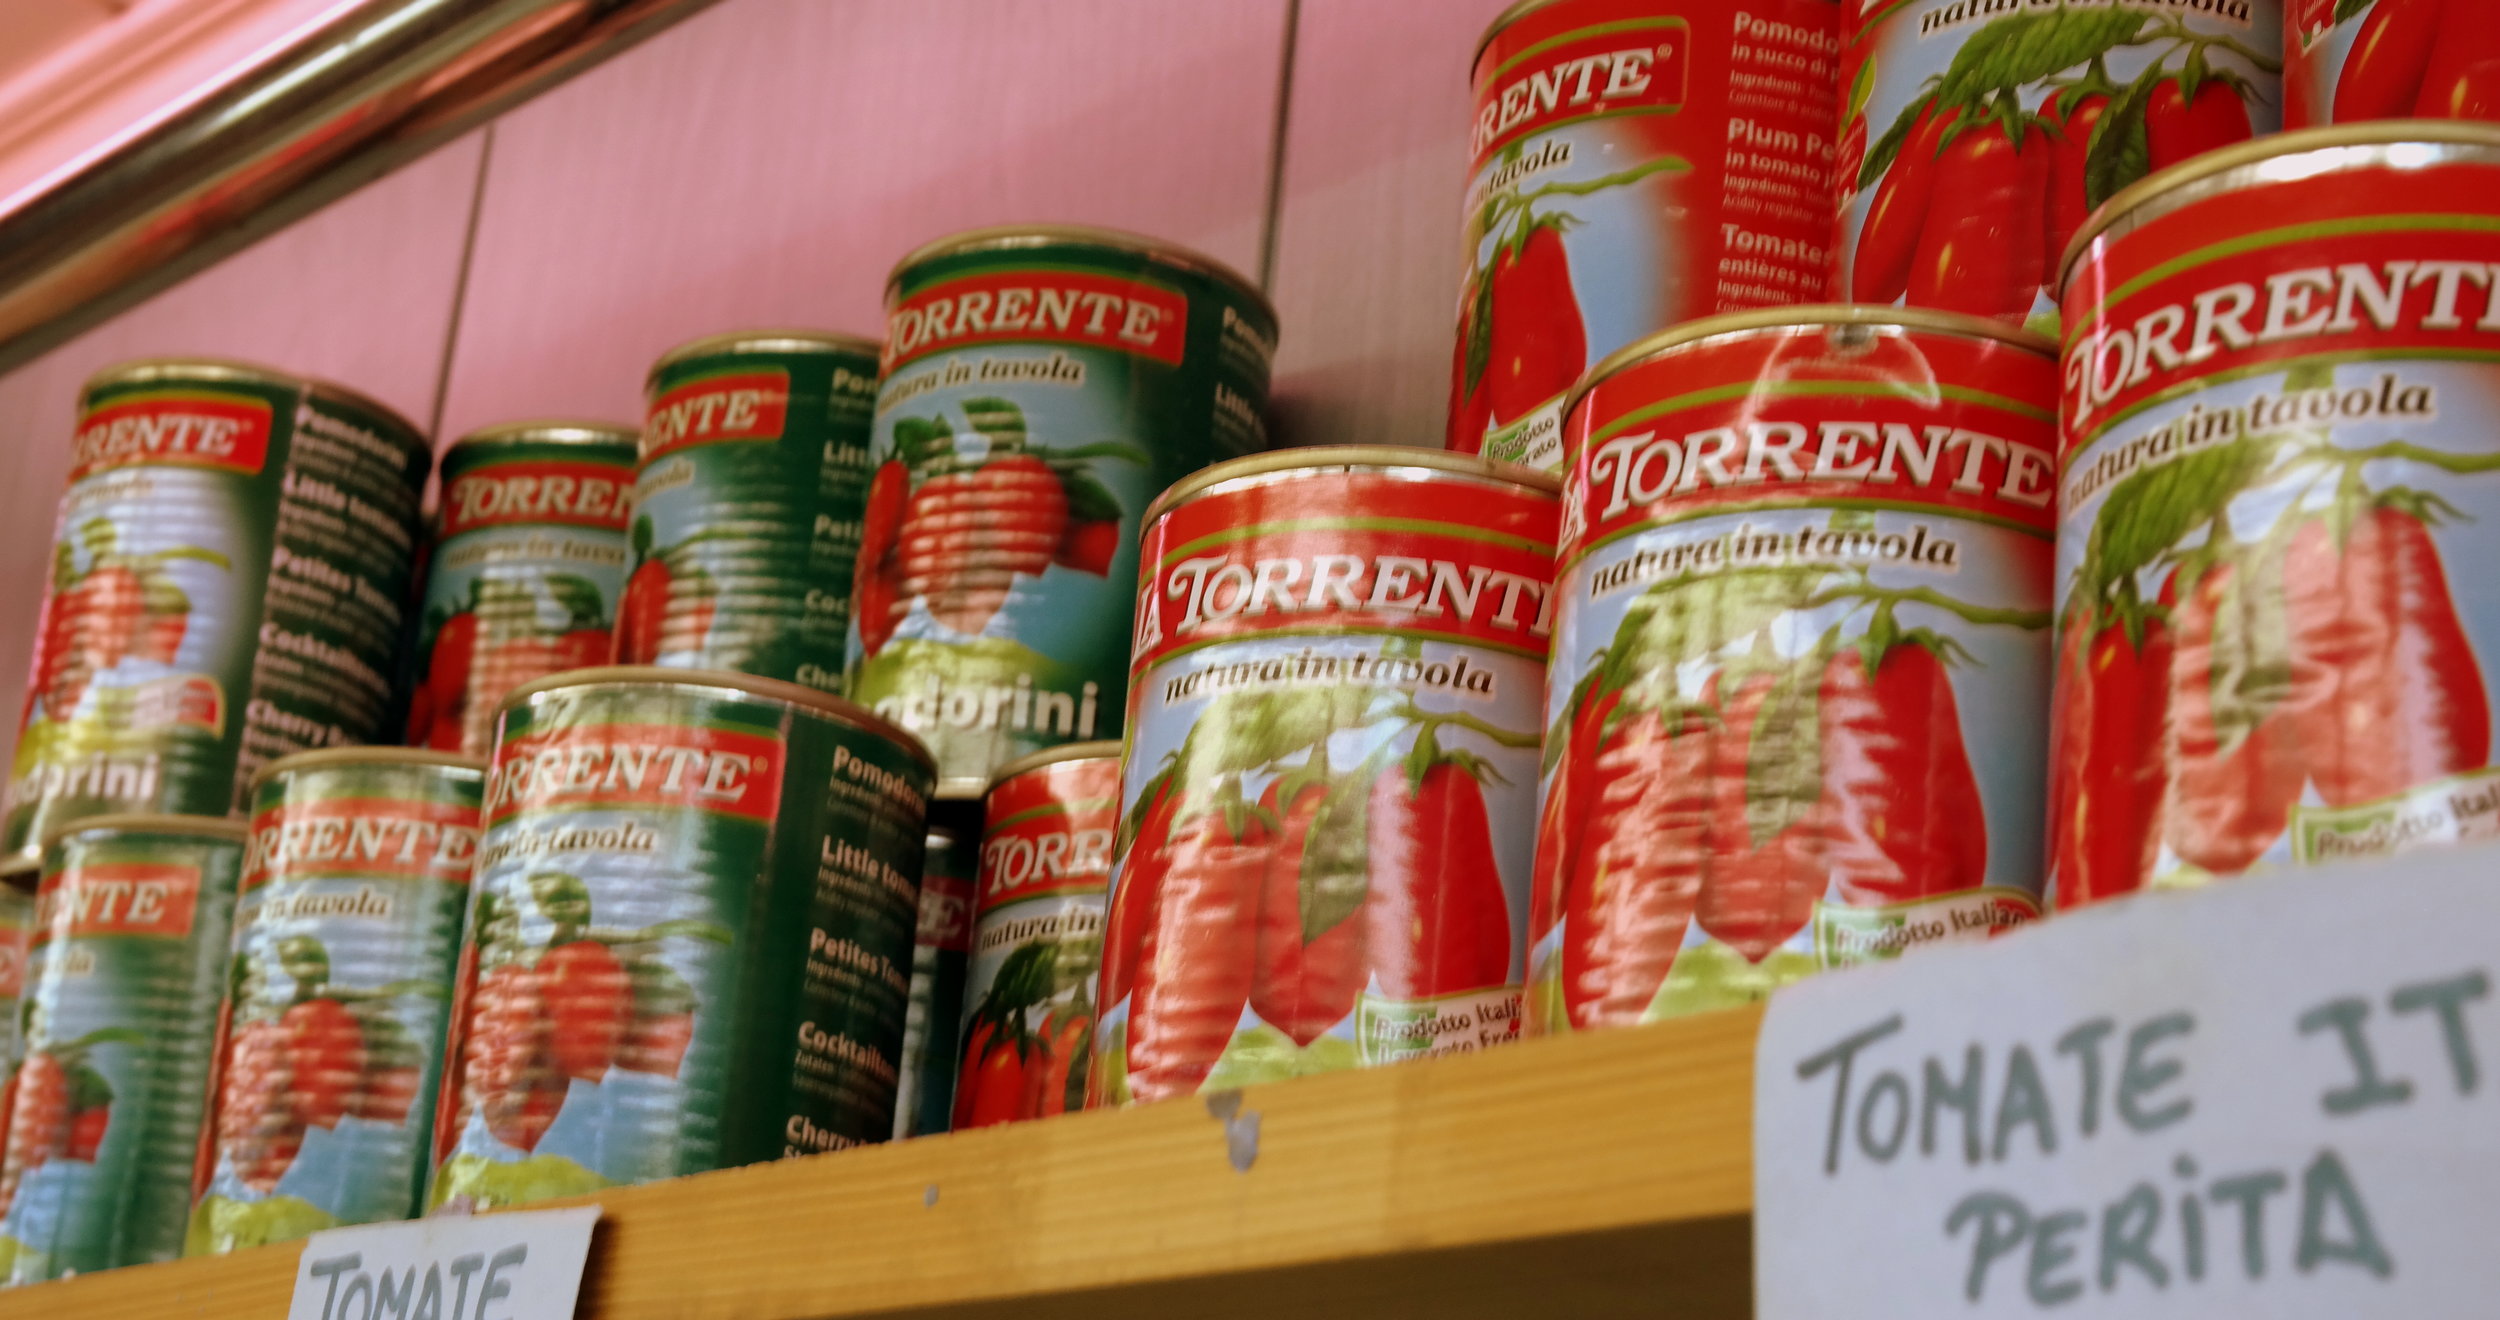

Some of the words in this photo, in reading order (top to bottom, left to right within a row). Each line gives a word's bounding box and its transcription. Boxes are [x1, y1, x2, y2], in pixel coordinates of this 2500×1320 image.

[1732, 40, 1751, 61] in
[1755, 47, 1806, 72] succo
[1472, 48, 1654, 160] RENTE
[1727, 117, 1799, 154] Plum
[1725, 148, 1746, 168] in
[1750, 153, 1821, 182] tomato
[979, 354, 1082, 382] tavola
[645, 388, 760, 450] ENTE
[2188, 403, 2238, 445] in
[2250, 373, 2432, 429] tavola
[1590, 421, 2055, 522] TORRENTE
[1592, 537, 1722, 598] natura
[1735, 523, 1783, 559] in
[1799, 525, 1957, 566] tavola
[1165, 656, 1287, 704] natura
[1296, 645, 1337, 679] in
[1351, 652, 1493, 693] tavola
[549, 821, 656, 852] tavola
[822, 835, 879, 879] Little
[1067, 905, 1098, 932] in
[1375, 1011, 1472, 1040] Prodotto
[1796, 1012, 2197, 1178] TOMATE
[2298, 970, 2490, 1117] IT
[310, 1242, 529, 1320] TOMATE
